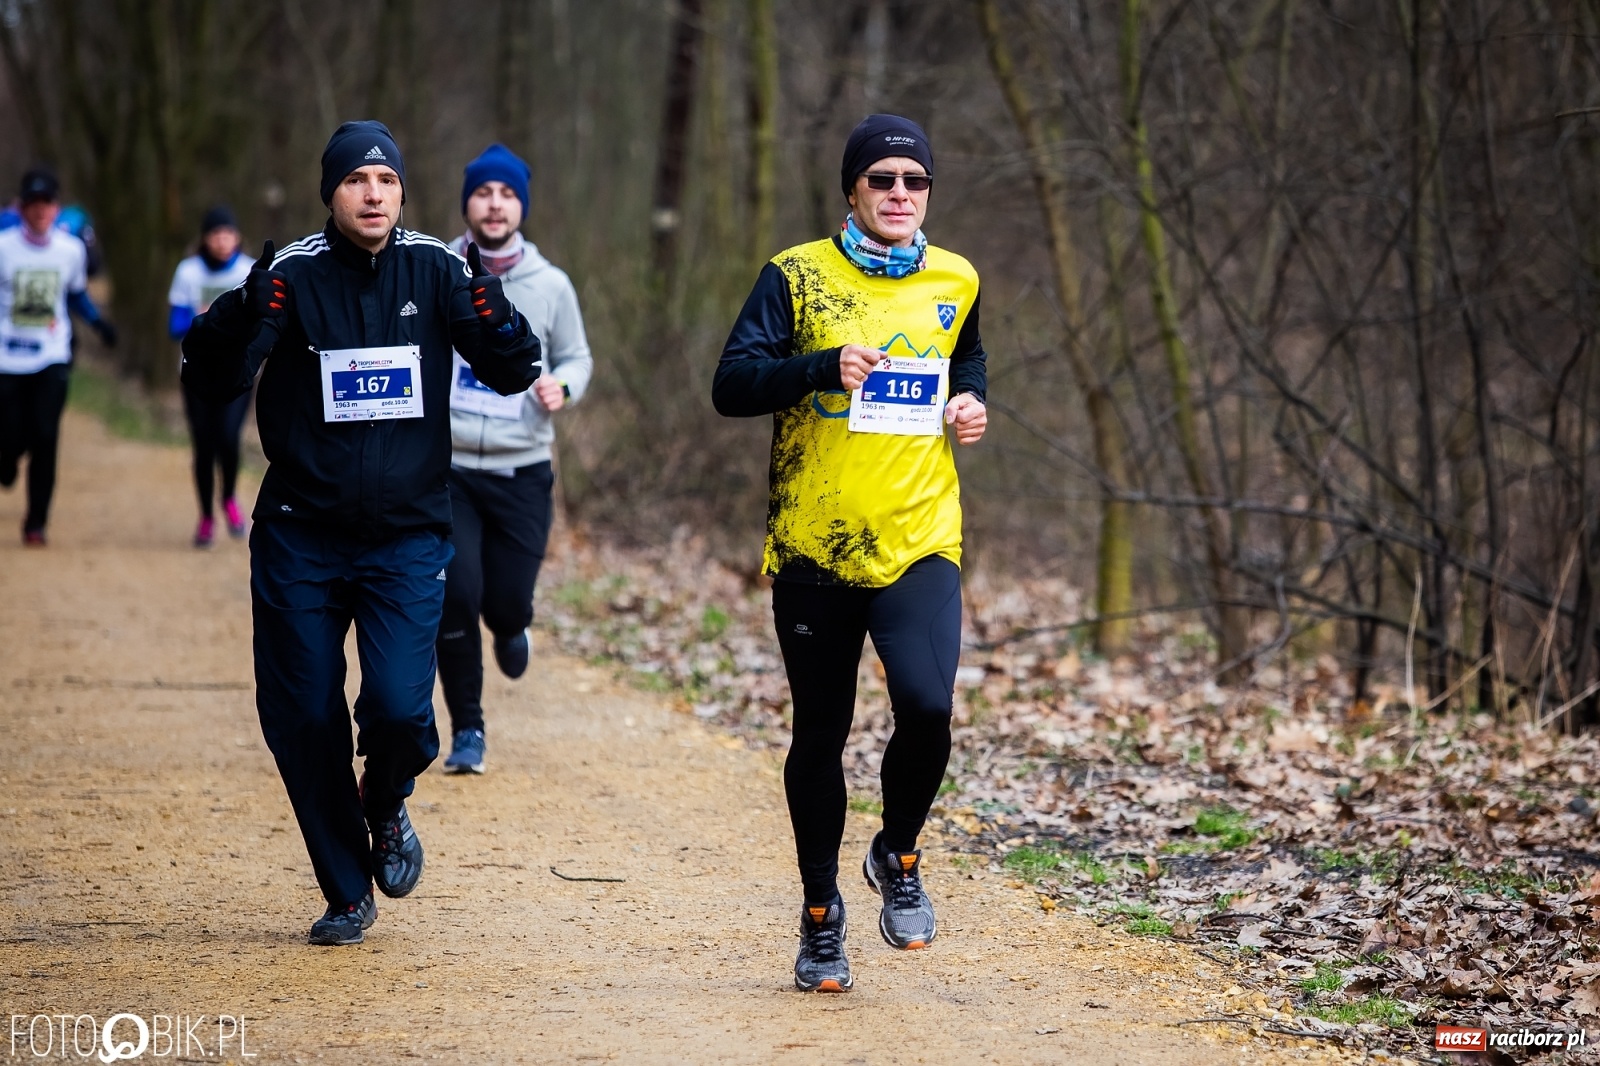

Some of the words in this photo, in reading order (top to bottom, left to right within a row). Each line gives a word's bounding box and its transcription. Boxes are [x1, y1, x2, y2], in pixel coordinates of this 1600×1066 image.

[865, 239, 888, 250] TOYOTA
[356, 376, 390, 394] 167
[886, 379, 922, 399] 116
[861, 402, 878, 410] 1963
